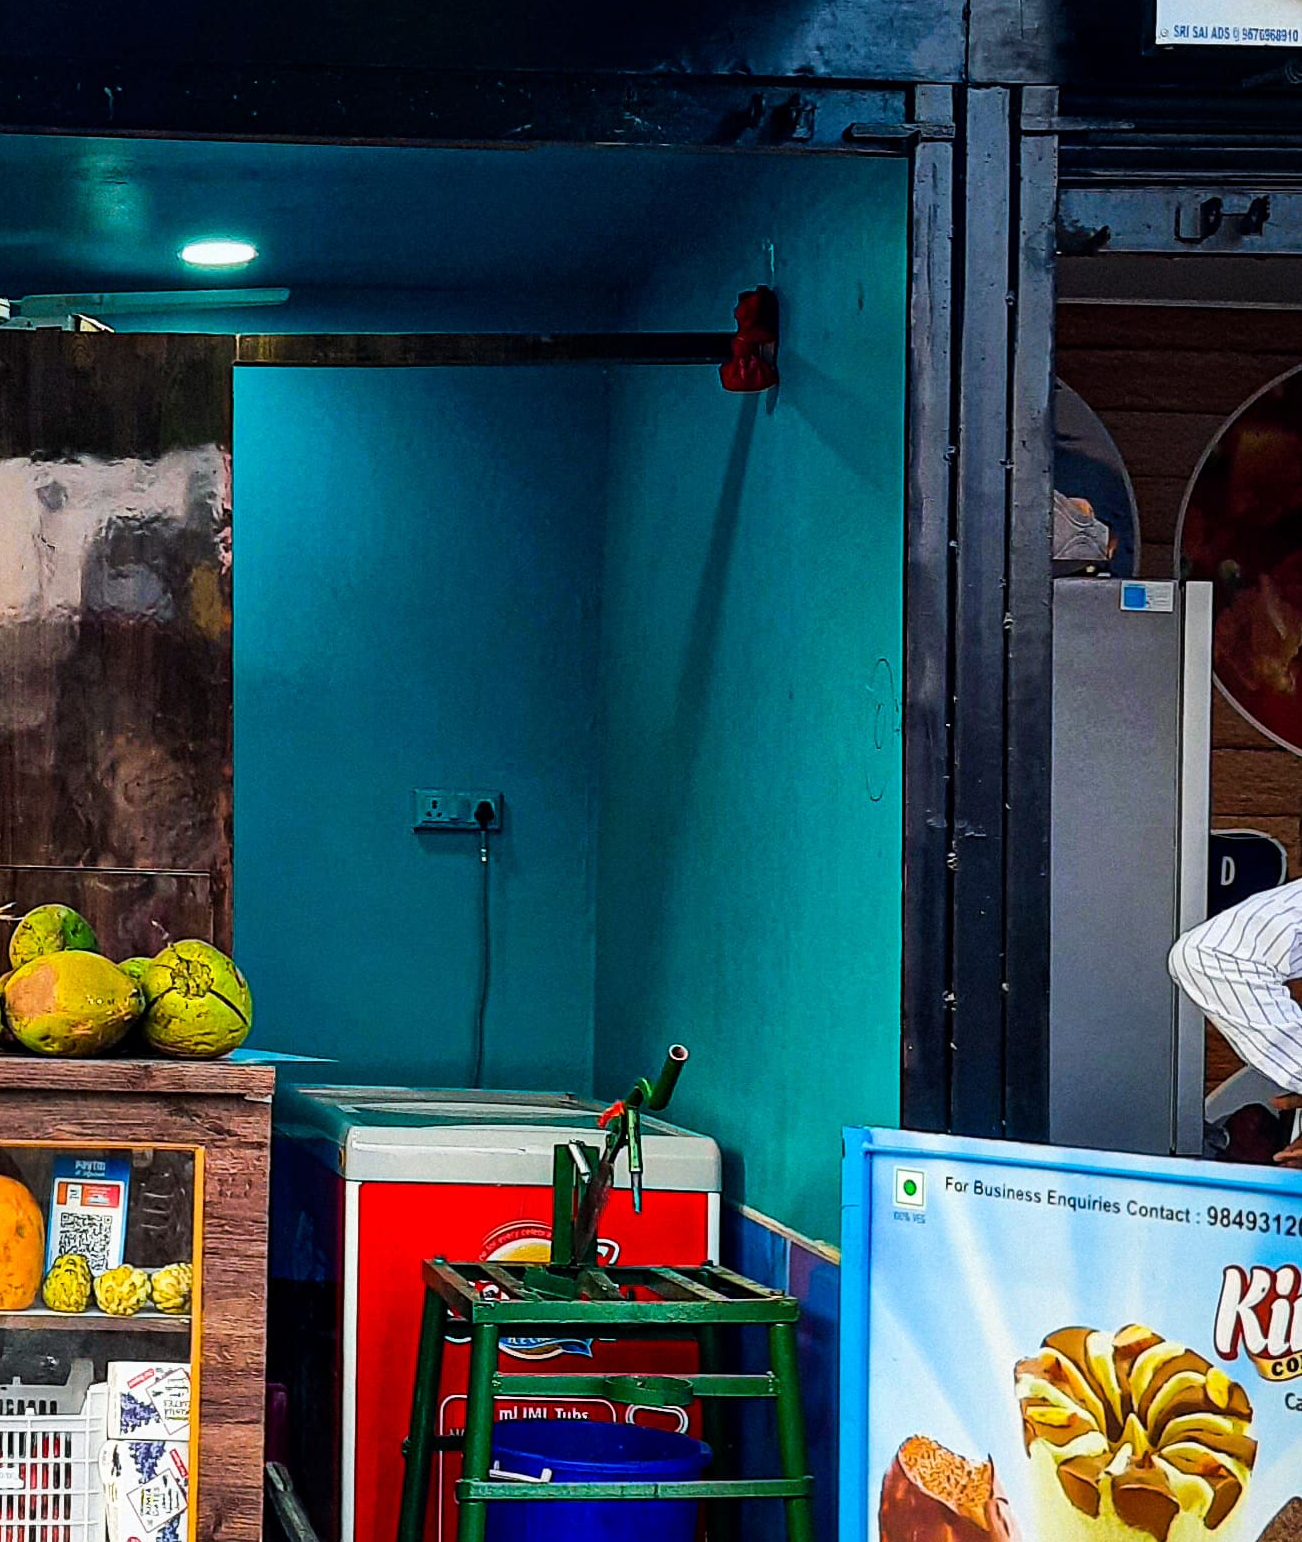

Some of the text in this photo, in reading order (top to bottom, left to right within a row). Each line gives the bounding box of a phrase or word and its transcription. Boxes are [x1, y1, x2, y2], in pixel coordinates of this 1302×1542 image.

[945, 1176, 969, 1193] For
[973, 1179, 1042, 1204] Business
[1047, 1189, 1121, 1215] Enquiries
[1126, 1199, 1191, 1224] Contact
[1214, 1264, 1302, 1360] Ki
